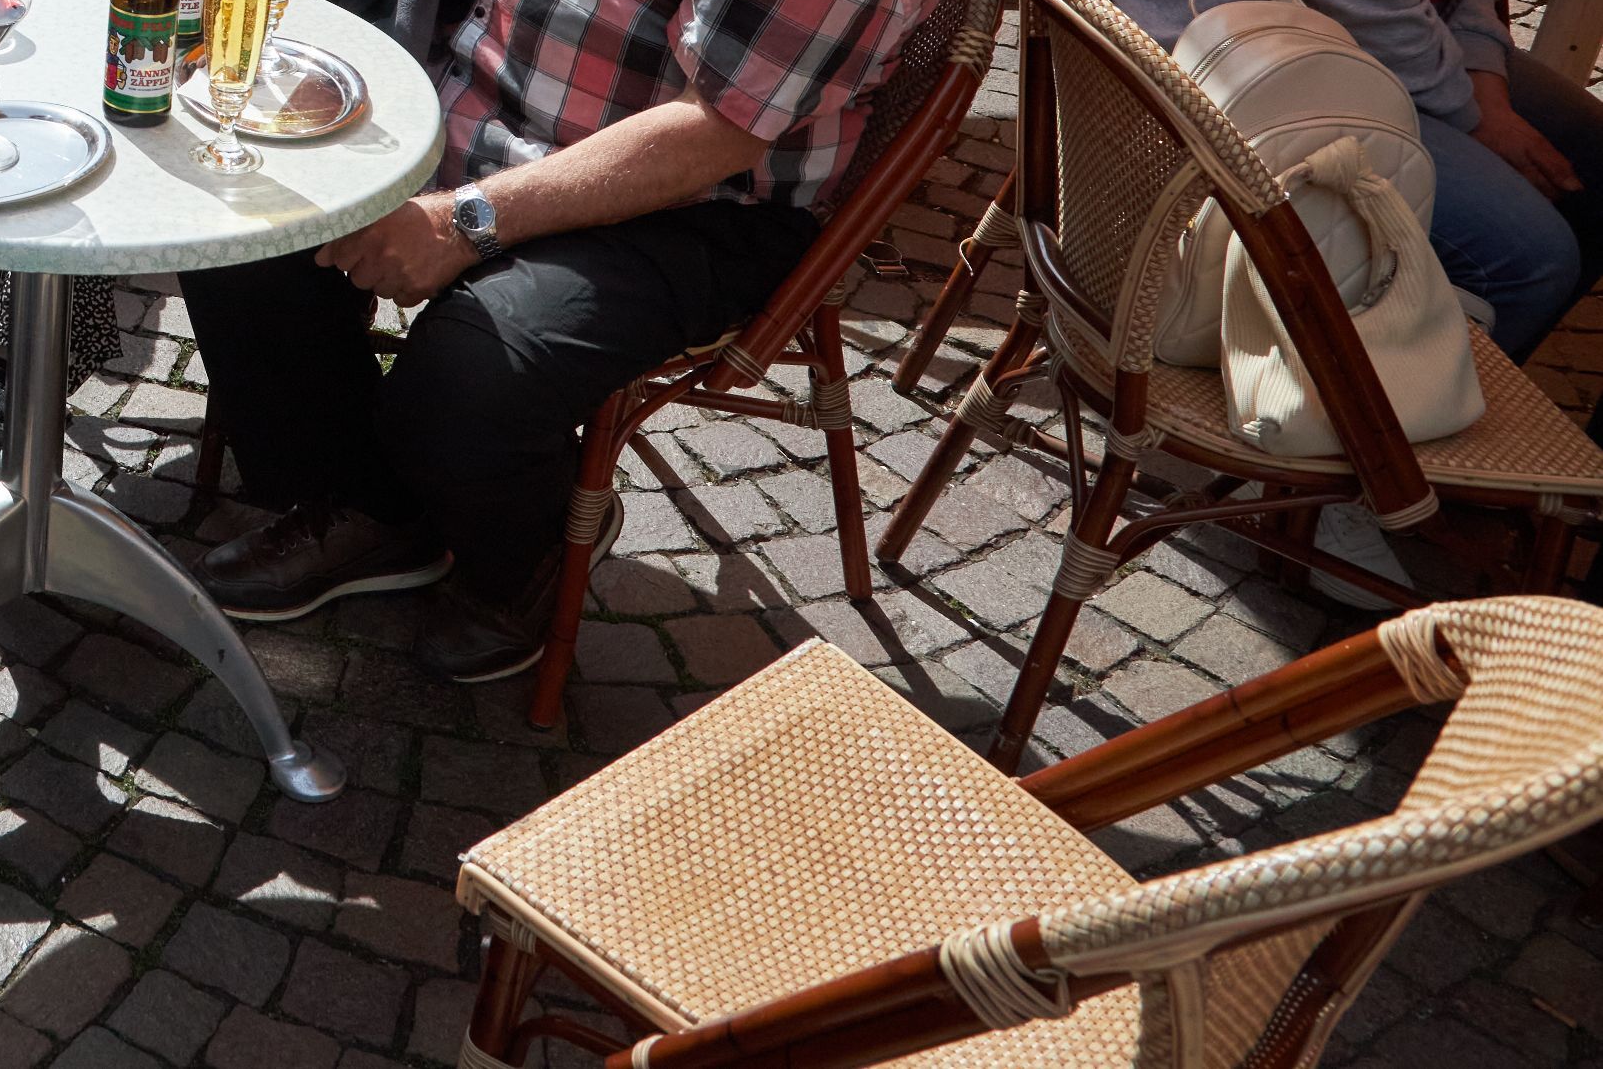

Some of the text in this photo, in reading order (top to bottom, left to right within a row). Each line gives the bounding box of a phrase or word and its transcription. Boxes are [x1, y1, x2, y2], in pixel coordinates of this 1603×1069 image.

[180, 1, 201, 11] FLE
[130, 66, 172, 78] TANNEN
[130, 77, 171, 87] ZÄPFLE
